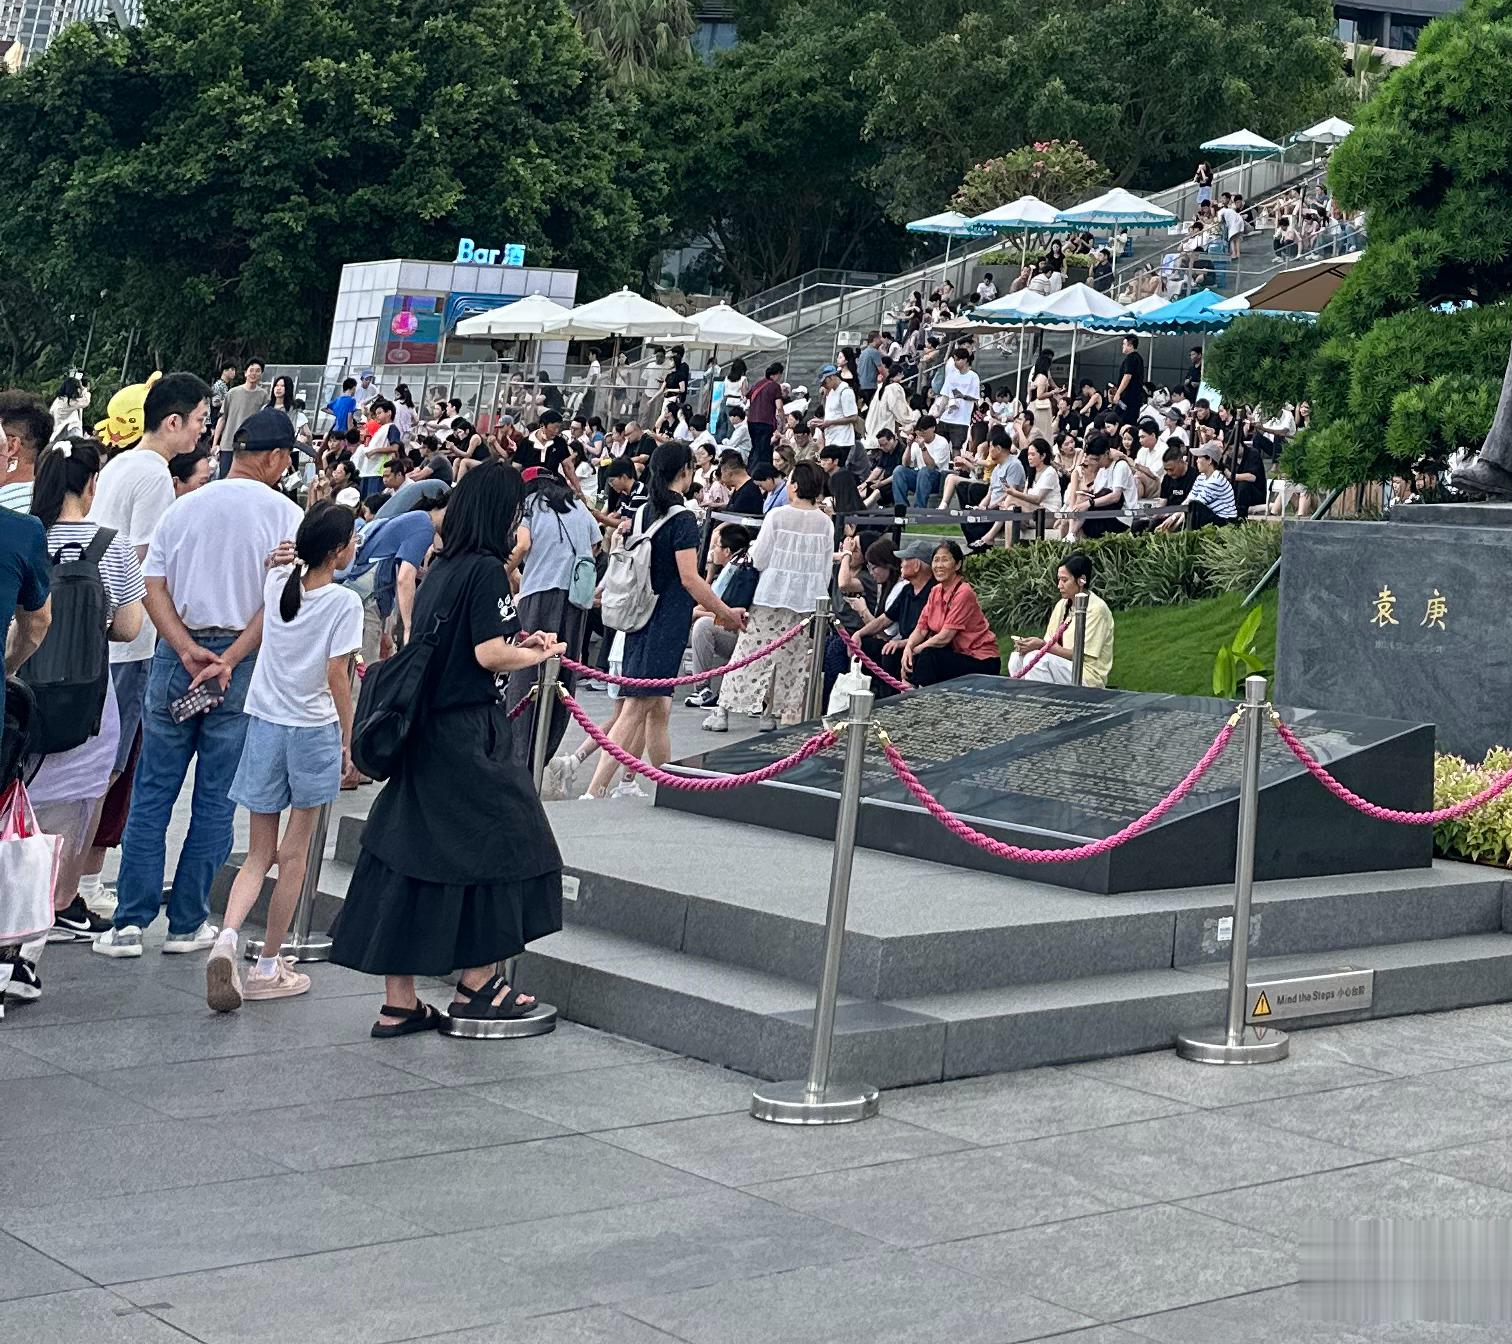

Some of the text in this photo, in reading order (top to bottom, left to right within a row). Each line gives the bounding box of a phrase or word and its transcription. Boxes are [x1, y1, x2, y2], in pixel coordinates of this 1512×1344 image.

[457, 238, 526, 267] Bar 酒
[1369, 584, 1448, 631] 袁庚
[1277, 985, 1366, 1005] Mind the Steps 小心台阶
